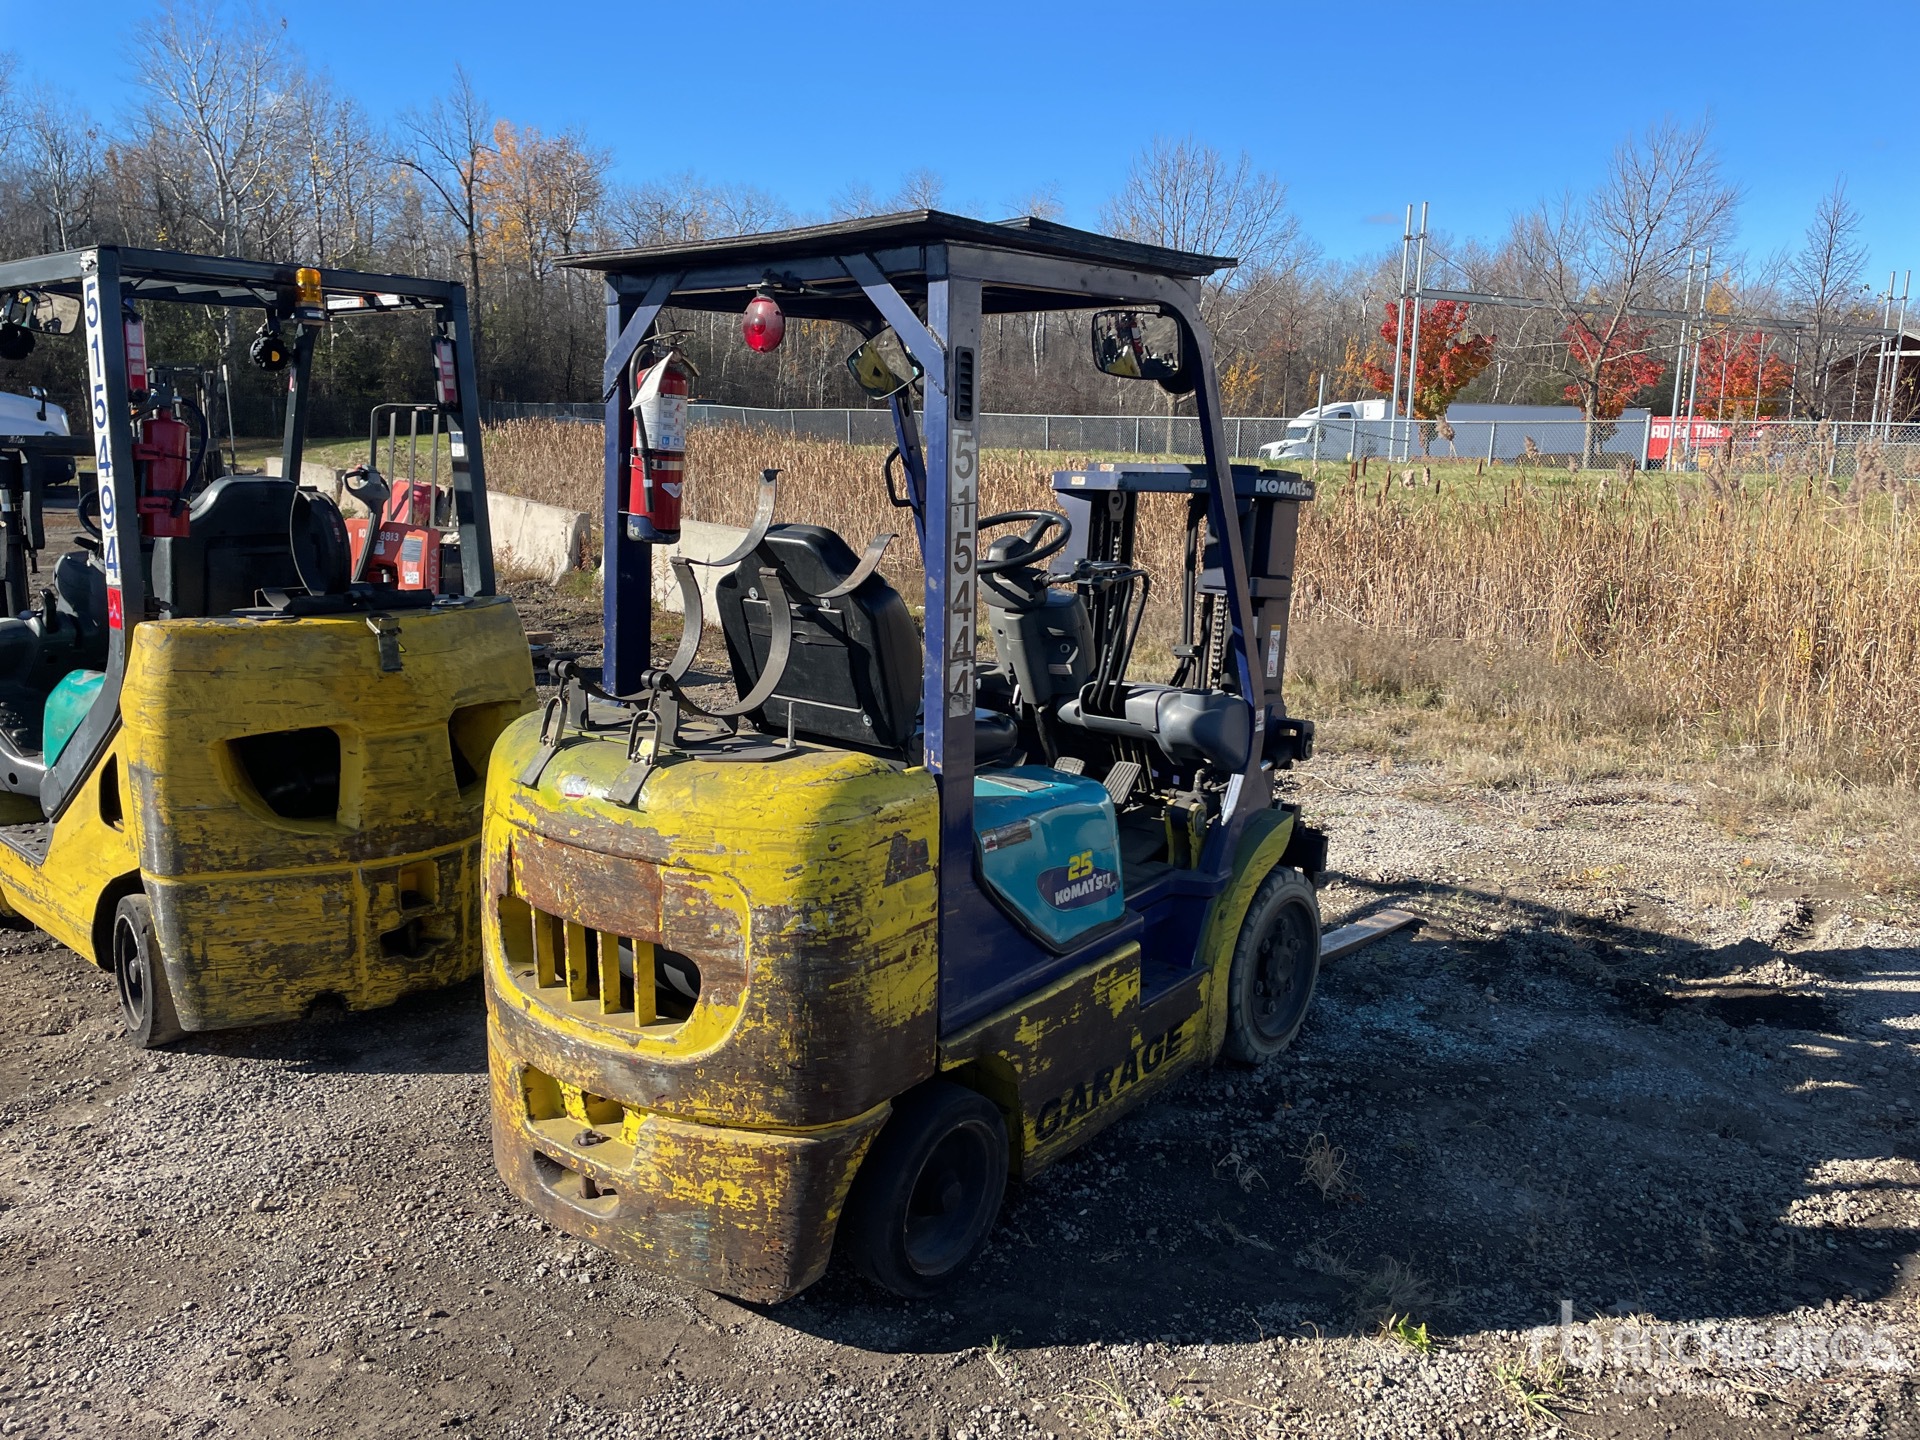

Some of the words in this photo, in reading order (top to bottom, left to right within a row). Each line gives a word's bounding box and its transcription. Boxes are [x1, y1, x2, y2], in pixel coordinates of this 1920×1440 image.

[86, 282, 118, 579] 515494
[1255, 479, 1312, 497] KOMATSU
[380, 531, 399, 542] 8813
[429, 548, 438, 594] OYOTA
[952, 435, 975, 710] 515444
[1067, 848, 1094, 882] 25
[1054, 872, 1112, 906] KOMATSU
[1034, 1021, 1184, 1141] GARAGE
